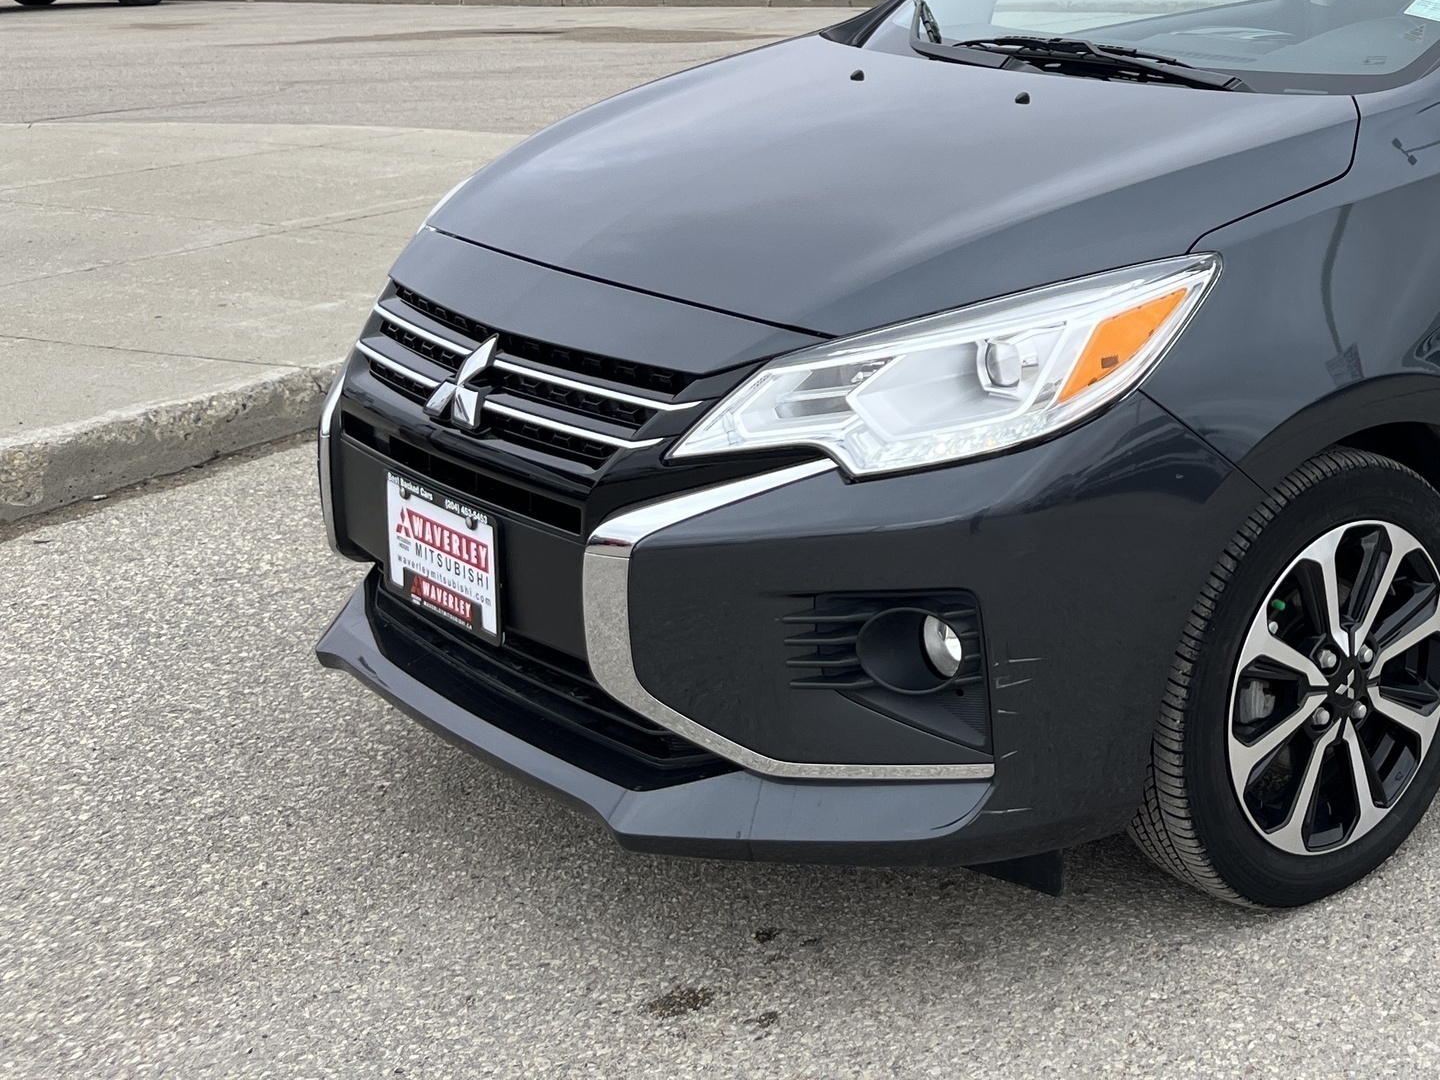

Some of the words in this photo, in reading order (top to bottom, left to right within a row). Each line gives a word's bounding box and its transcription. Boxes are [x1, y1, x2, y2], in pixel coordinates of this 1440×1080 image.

[420, 487, 434, 501] Cars
[412, 514, 488, 570] WAVERLEY
[414, 542, 489, 591] MITSUBISHI
[397, 554, 492, 606] waverleymitsubishi.com
[421, 580, 472, 618] WAVERLEY
